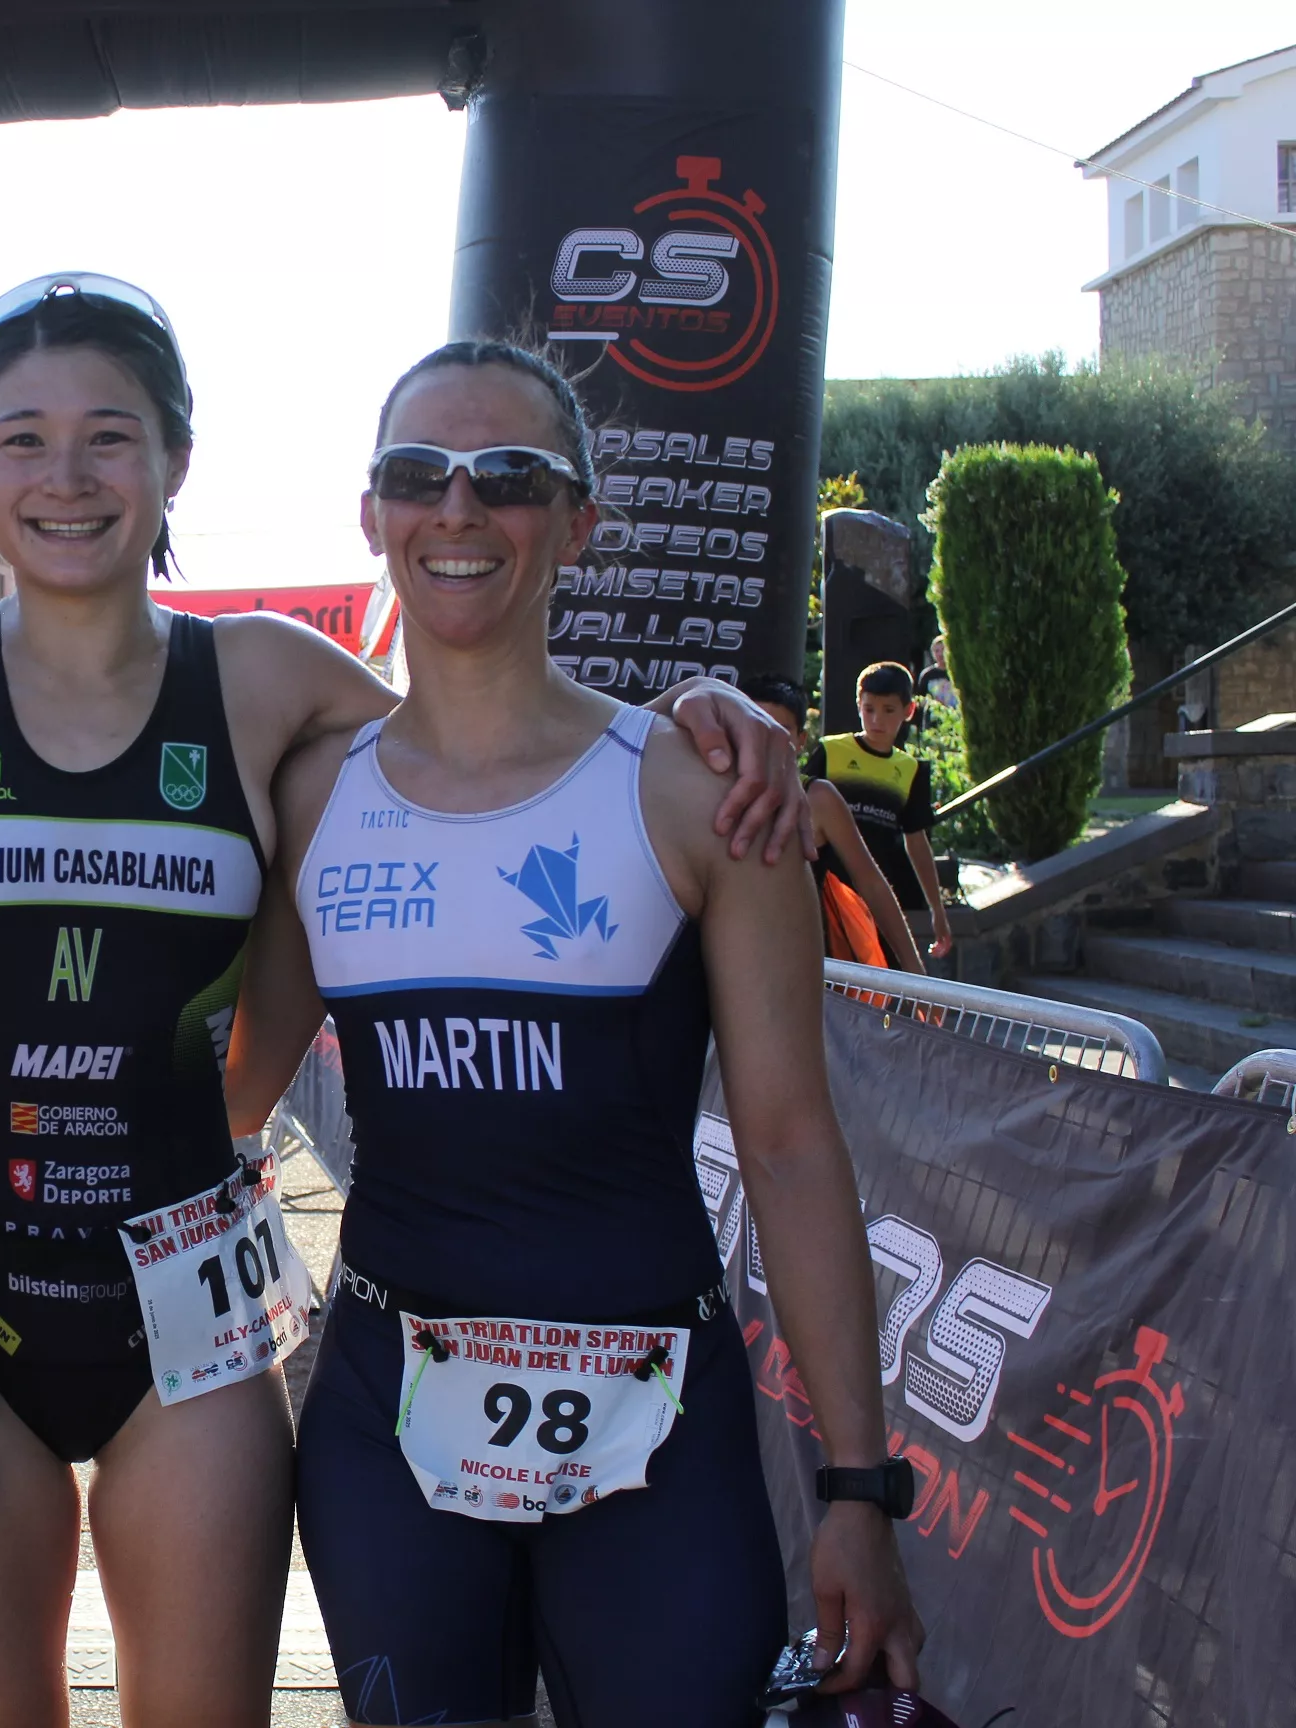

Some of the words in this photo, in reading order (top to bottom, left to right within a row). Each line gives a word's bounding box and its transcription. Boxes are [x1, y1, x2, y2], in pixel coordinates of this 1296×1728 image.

[550, 227, 740, 307] CS
[550, 304, 731, 333] EVENTOS
[589, 428, 774, 471] RSALES
[594, 474, 772, 517] EAKER
[592, 521, 768, 562] OFEOS
[553, 565, 765, 608] AMISETAS
[361, 810, 410, 829] TACTIC
[54, 849, 215, 896] CASABLANCA
[317, 862, 440, 899] COIX
[316, 897, 436, 937] TEAM
[48, 927, 102, 1002] AV
[10, 1043, 124, 1080] MAPEI
[374, 1017, 564, 1091] MARTIN
[39, 1106, 118, 1121] GOBIERNO
[39, 1119, 58, 1136] DE
[64, 1120, 128, 1136] ARAGON
[44, 1161, 130, 1183] Zaragoza
[43, 1183, 132, 1206] DEPORTE
[135, 1236, 177, 1268] SAN
[198, 1218, 281, 1318] 101
[8, 1272, 127, 1303] bilsteingroup
[268, 1327, 288, 1352] barri
[454, 1320, 580, 1349] TRIATLON
[587, 1330, 678, 1354] SPRINT
[412, 1334, 458, 1358] SN
[464, 1339, 523, 1368] JUAN
[527, 1350, 572, 1371] DEL
[579, 1353, 674, 1379] FLUMN
[483, 1383, 591, 1455] 98
[461, 1459, 529, 1483] NICOLE
